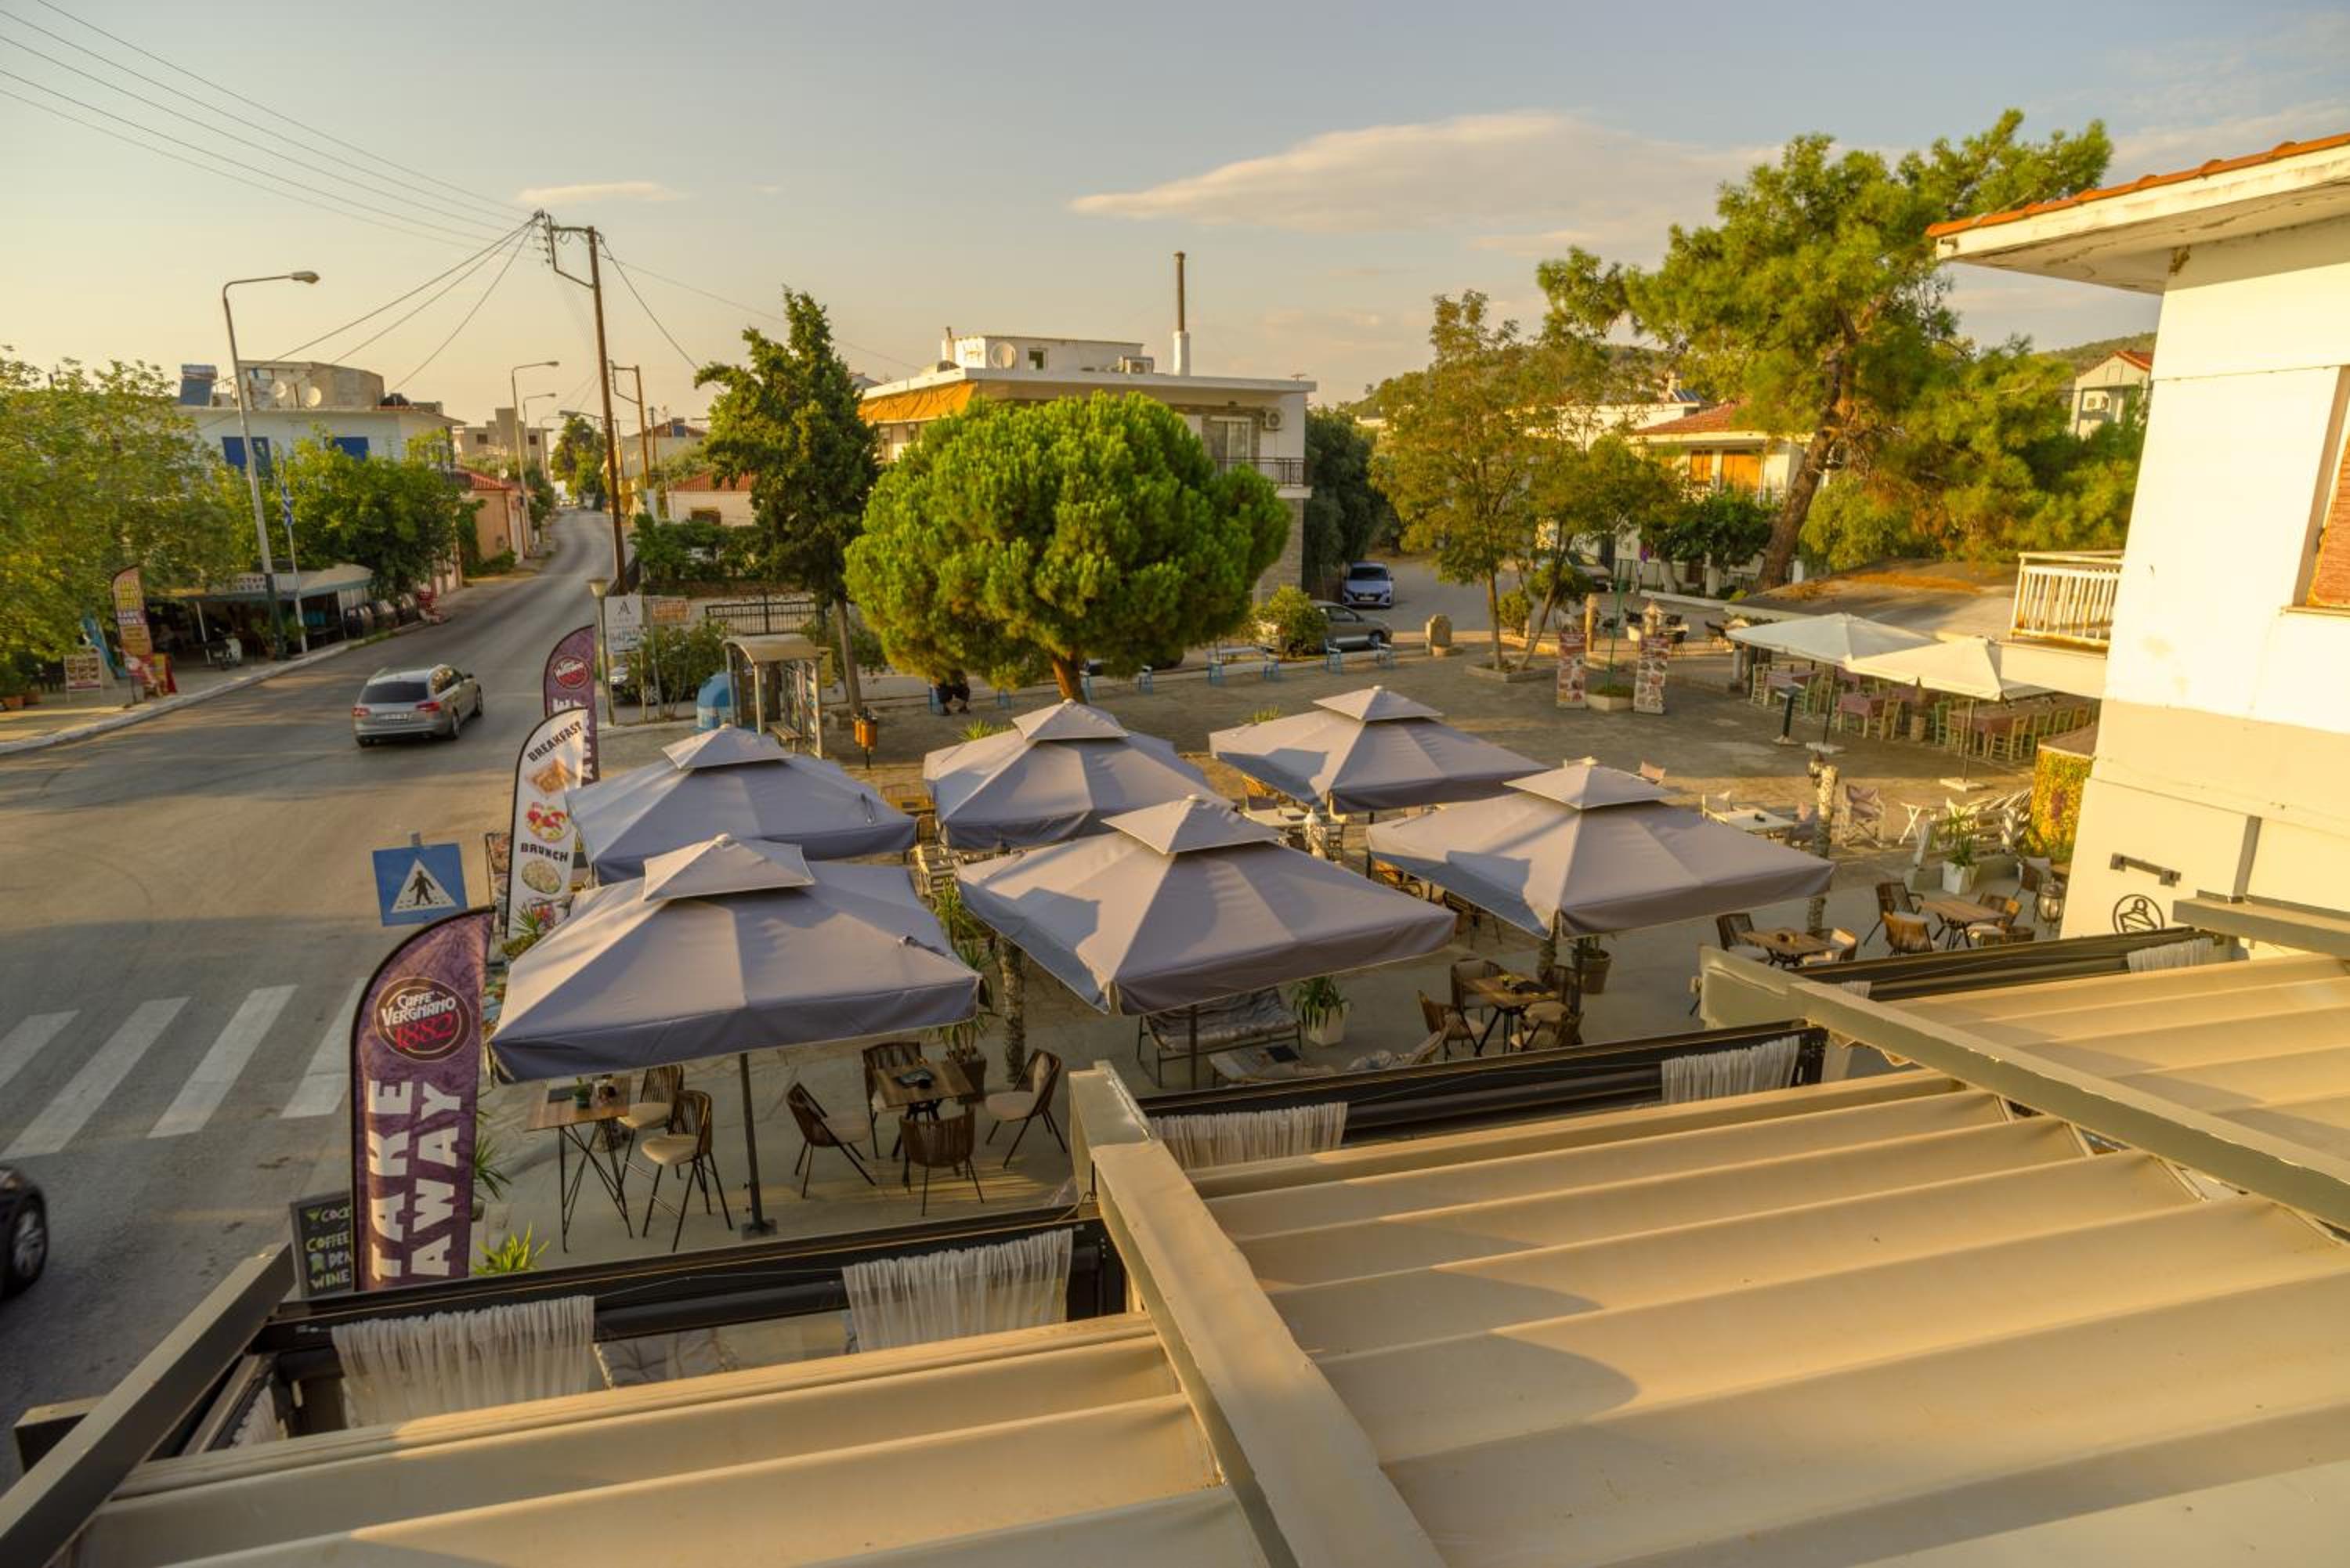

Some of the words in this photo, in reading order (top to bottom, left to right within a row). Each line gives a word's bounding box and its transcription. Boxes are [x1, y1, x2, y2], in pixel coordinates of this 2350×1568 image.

[528, 721, 582, 762] BREAKFAST
[520, 843, 569, 862] BRUNCH
[381, 997, 457, 1027] VERGNANO
[394, 1012, 455, 1050] 1882
[367, 1080, 414, 1282] TAKE
[410, 1081, 462, 1277] AWAY
